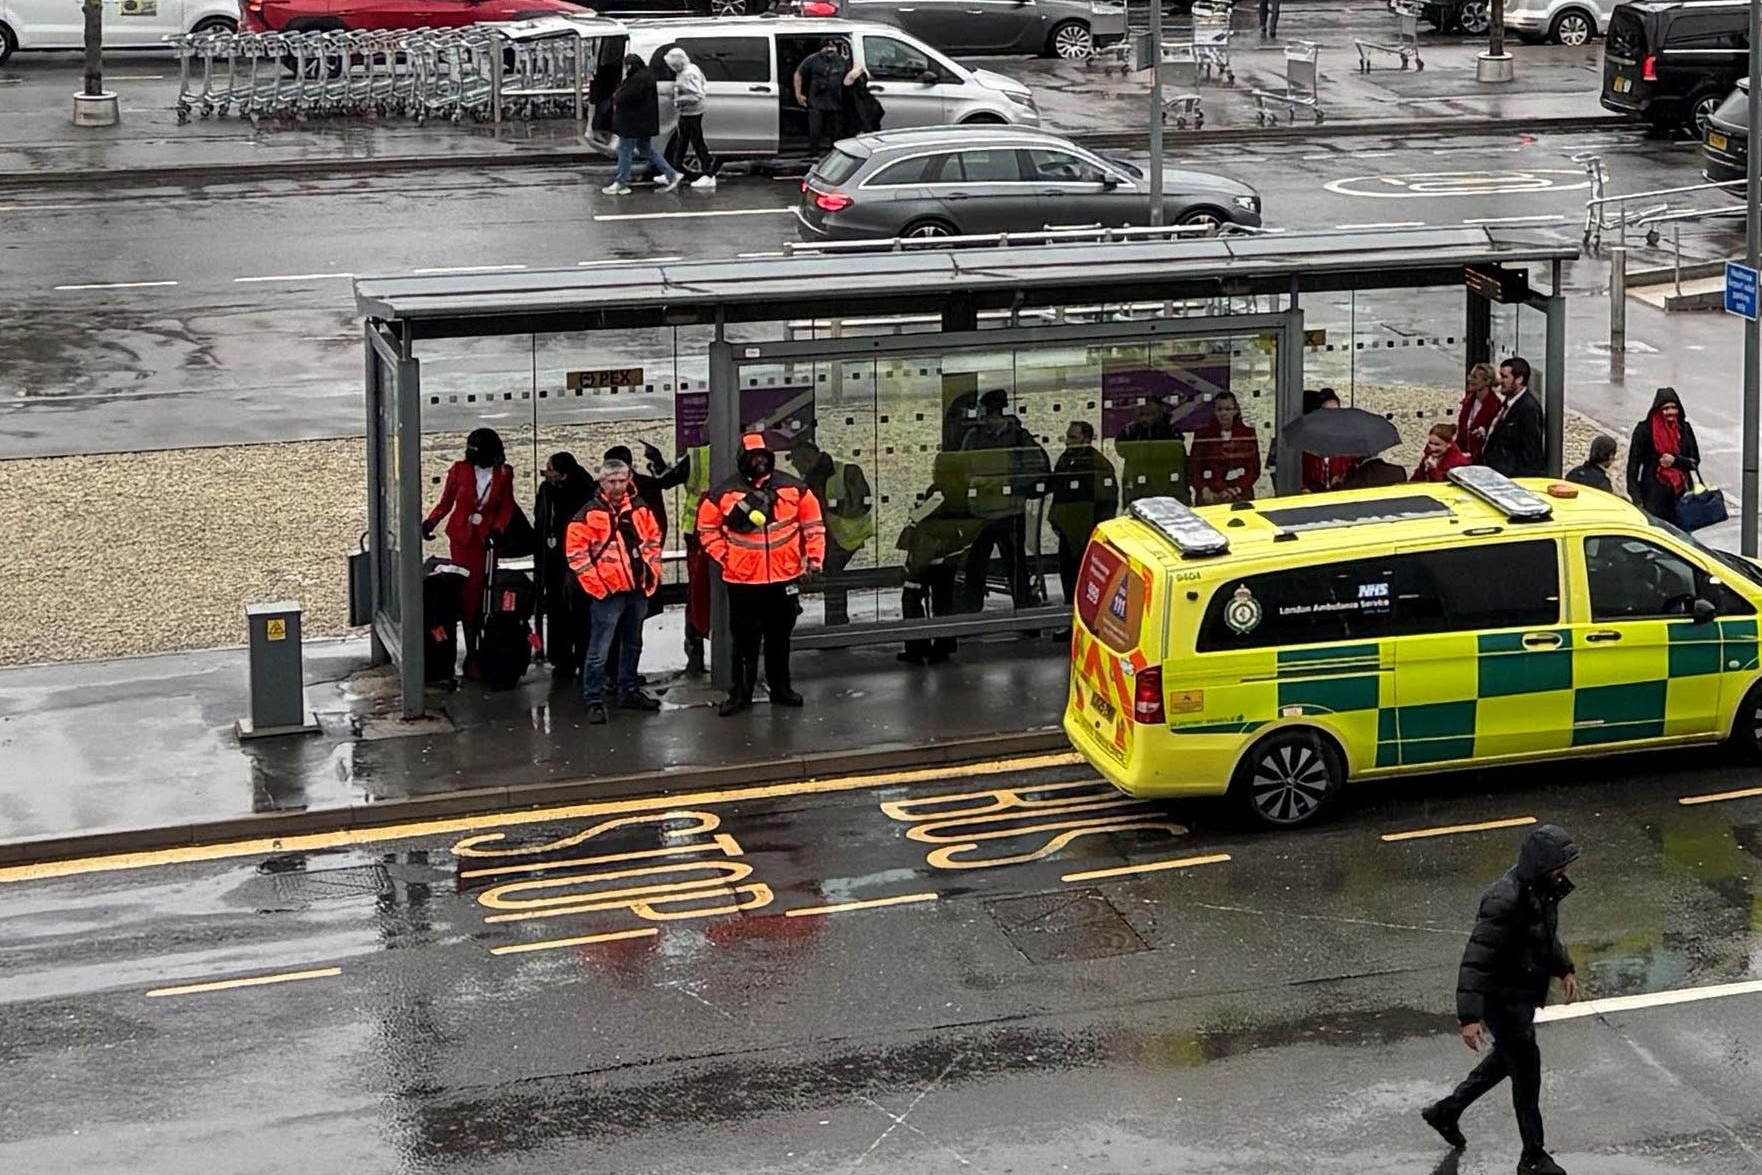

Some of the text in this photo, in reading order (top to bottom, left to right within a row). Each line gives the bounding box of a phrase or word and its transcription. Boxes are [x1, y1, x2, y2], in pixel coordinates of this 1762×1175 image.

[1358, 582, 1389, 598] NHS
[1279, 605, 1312, 616] London
[1313, 602, 1359, 613] Ambulance
[1360, 598, 1390, 609] Service
[451, 809, 775, 922] STOP
